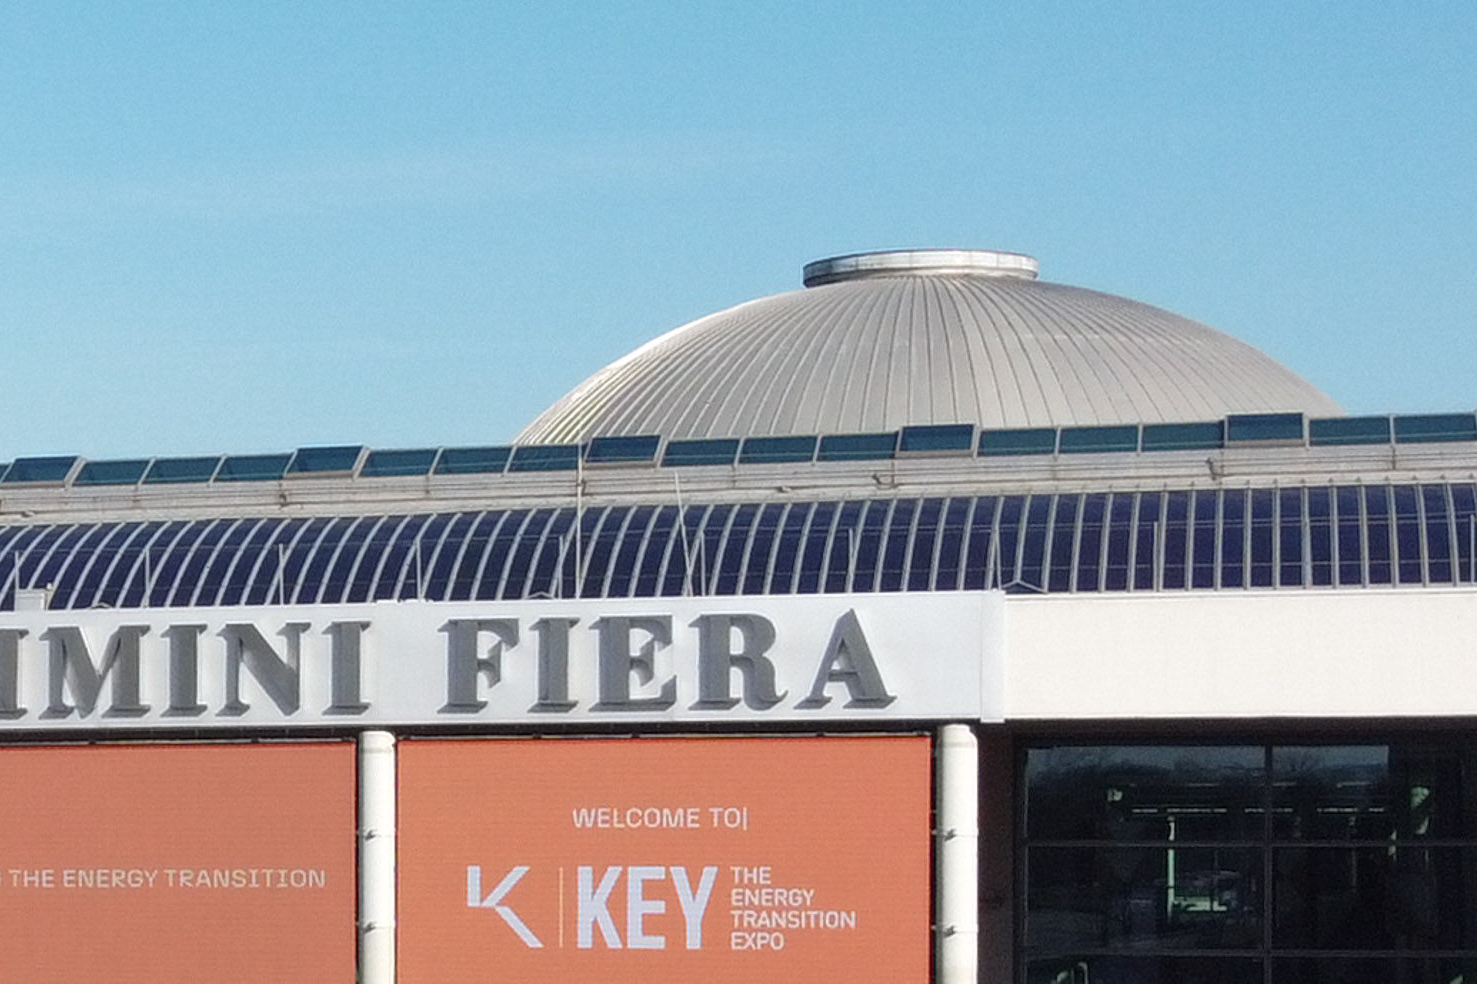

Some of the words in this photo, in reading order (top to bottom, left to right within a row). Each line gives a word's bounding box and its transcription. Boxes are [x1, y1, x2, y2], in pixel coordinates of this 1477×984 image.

[436, 608, 898, 713] FIERA
[572, 807, 701, 829] WELCOME
[8, 869, 55, 888] THE
[62, 869, 158, 888] ENERGY
[165, 869, 326, 889] TRANSITION
[730, 866, 772, 885] THE
[730, 889, 815, 906] ENERGY
[577, 865, 719, 951] KEY
[730, 911, 857, 929] TRANSITION
[730, 932, 785, 951] EXPO
